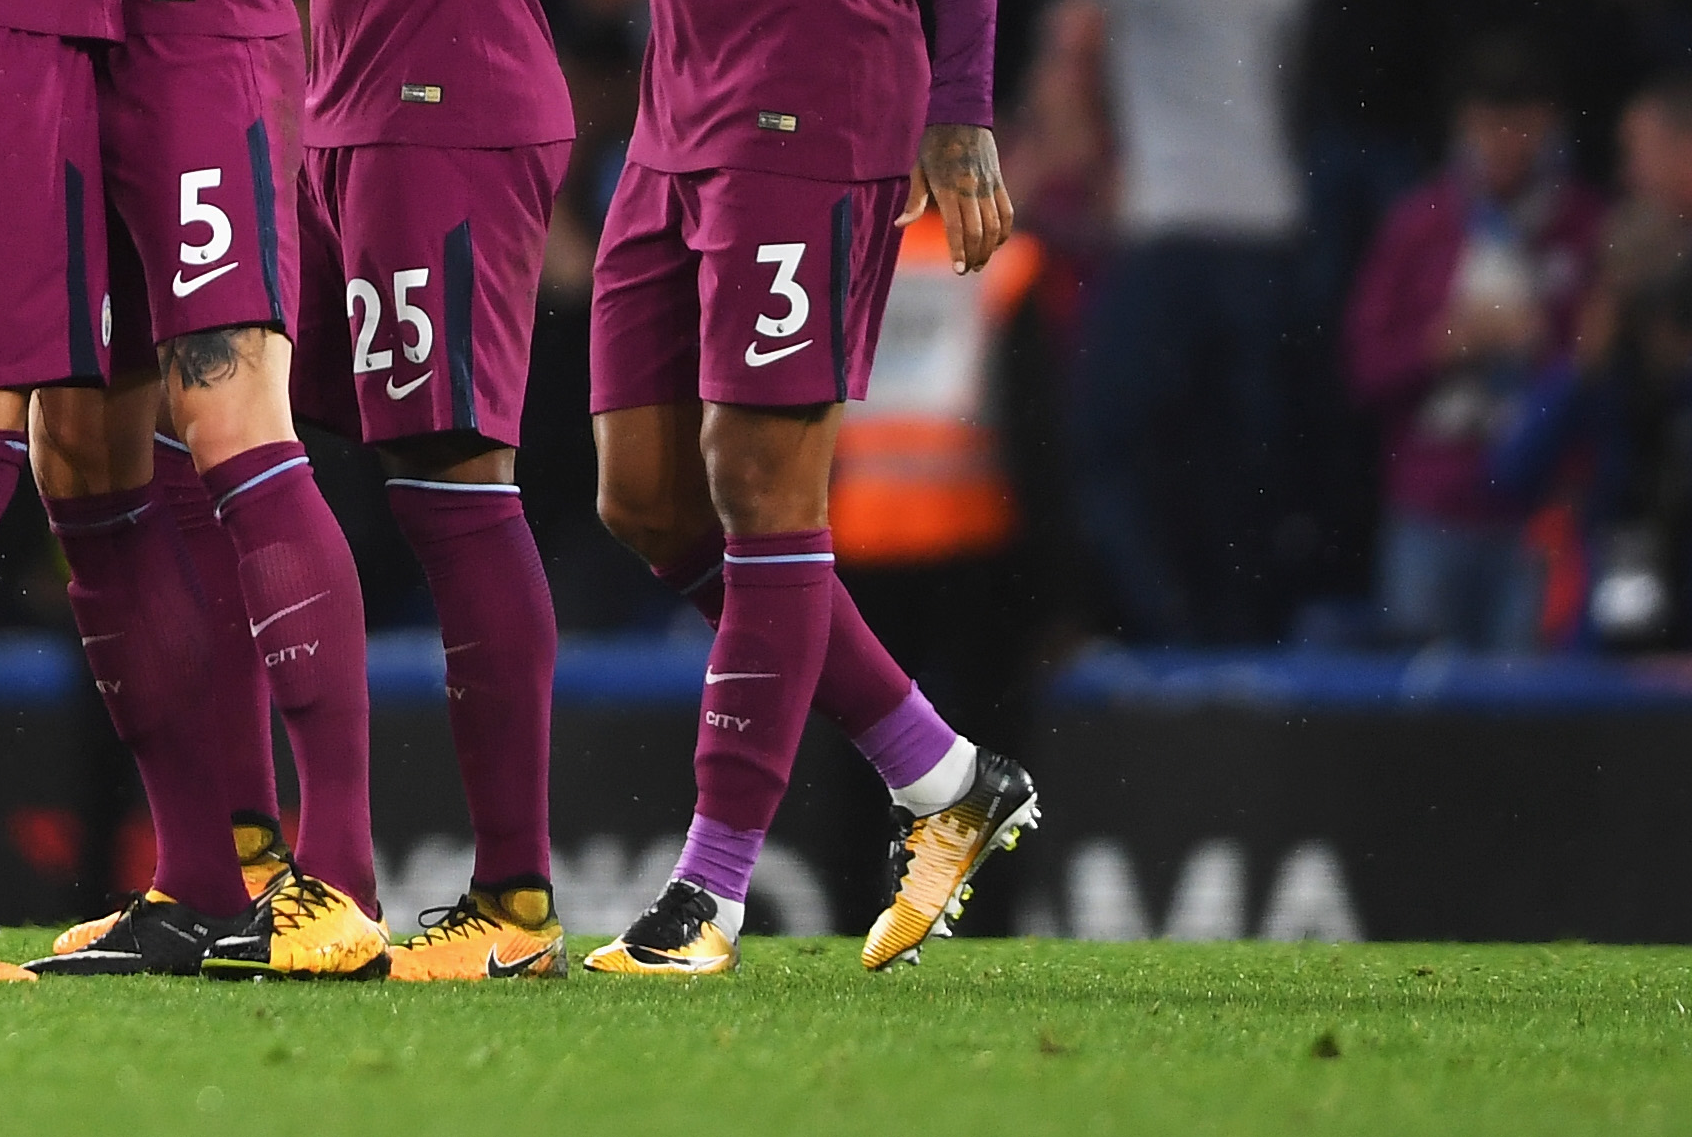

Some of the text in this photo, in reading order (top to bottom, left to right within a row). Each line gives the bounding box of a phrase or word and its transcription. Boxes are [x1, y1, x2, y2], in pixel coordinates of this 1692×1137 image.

[180, 167, 233, 265] 5
[346, 267, 434, 374] 25
[755, 243, 810, 338] 3
[264, 639, 320, 668] CITY
[705, 709, 751, 732] CITY
